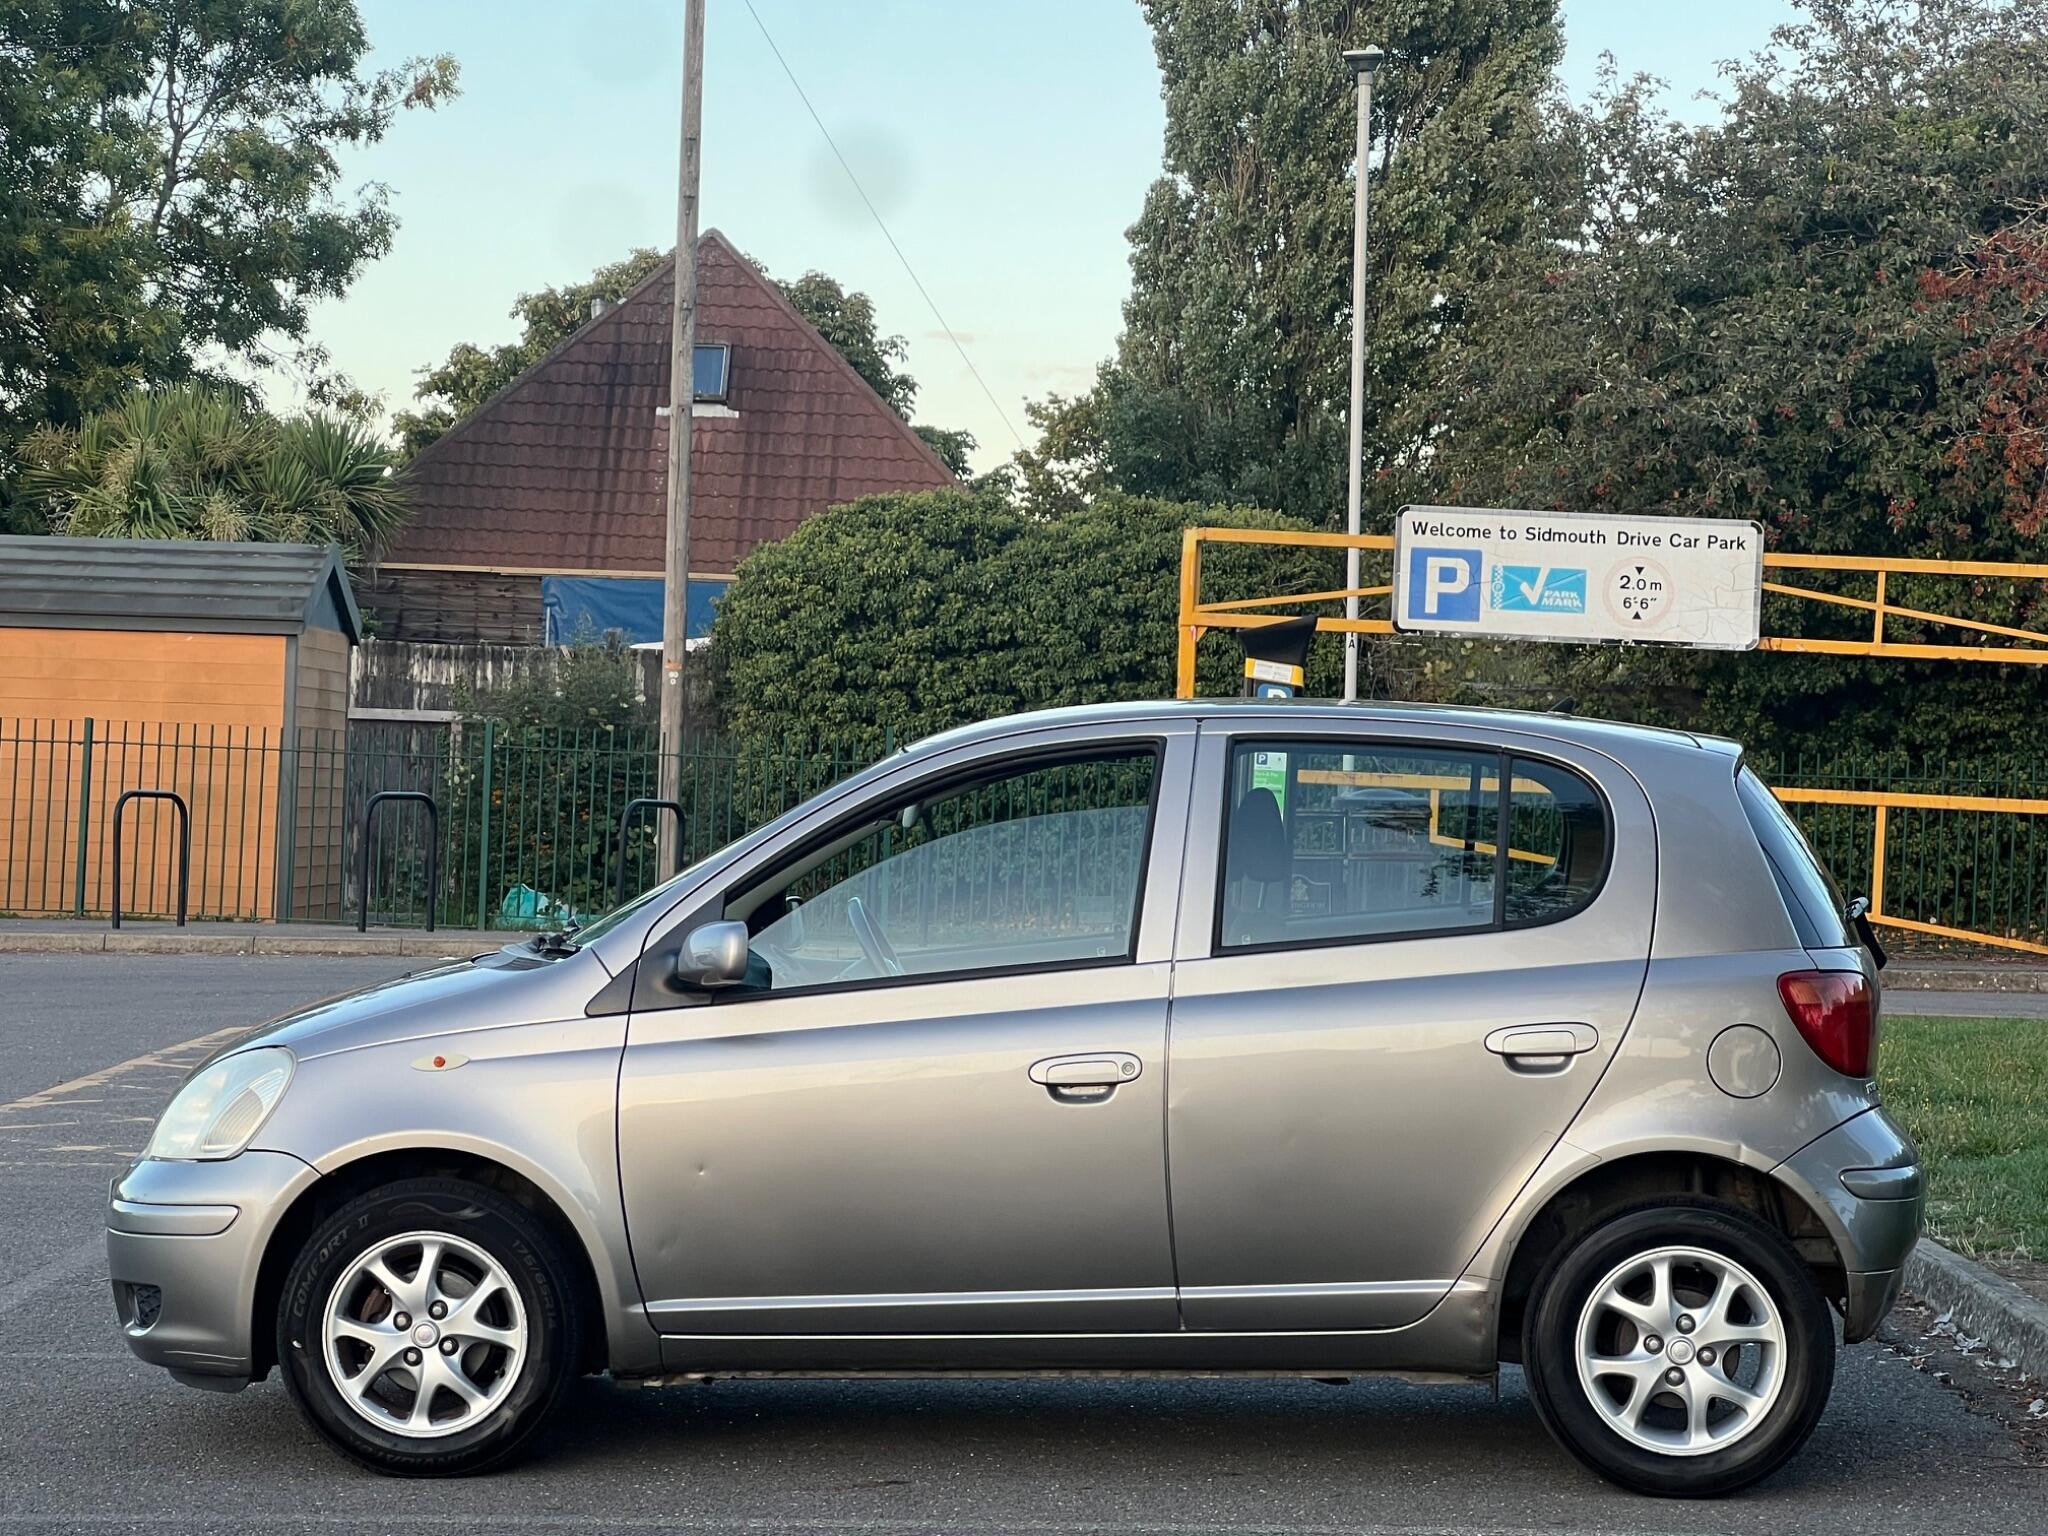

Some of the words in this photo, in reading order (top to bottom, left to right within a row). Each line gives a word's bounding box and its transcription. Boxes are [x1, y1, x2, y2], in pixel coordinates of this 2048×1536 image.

[1412, 521, 1492, 539] Welcome
[1500, 526, 1517, 540] to
[1525, 527, 1606, 544] Sidmouth
[1617, 531, 1662, 547] Drive
[1669, 533, 1700, 548] Car
[1707, 535, 1746, 550] Park
[1424, 556, 1470, 614] P
[1544, 590, 1579, 598] PARK
[1541, 598, 1582, 608] MARK
[293, 1224, 350, 1318] COMFORT
